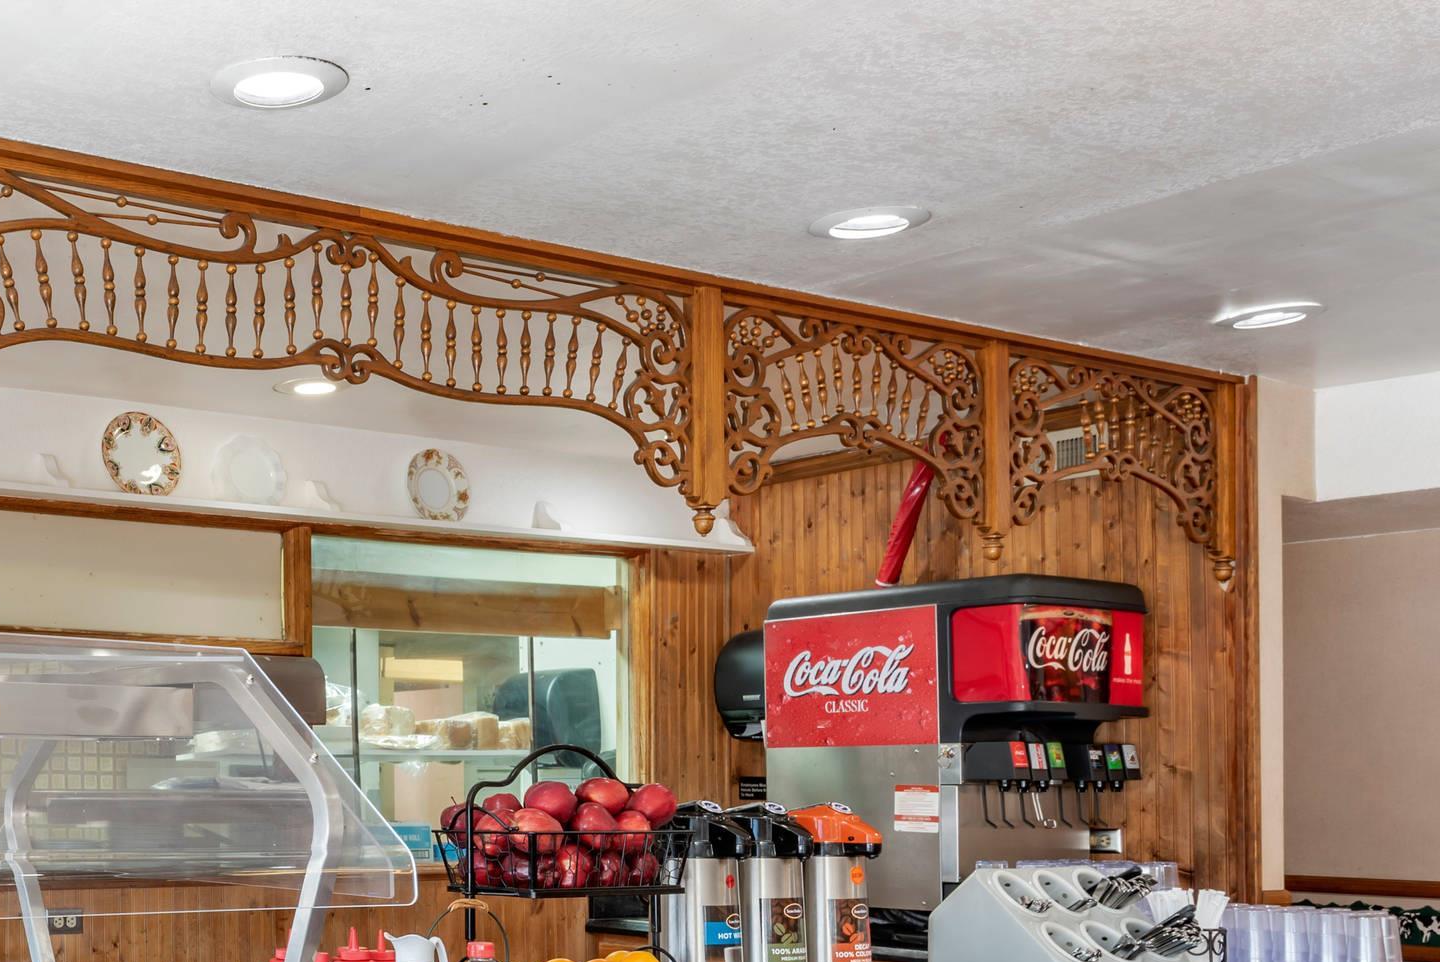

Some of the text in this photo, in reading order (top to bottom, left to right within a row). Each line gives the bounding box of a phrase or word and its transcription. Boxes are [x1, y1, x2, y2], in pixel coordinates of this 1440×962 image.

[1027, 626, 1111, 673] Coca-Cola
[783, 643, 915, 698] Coca-Cola
[824, 698, 869, 714] CLASSIC
[718, 932, 732, 940] HOT
